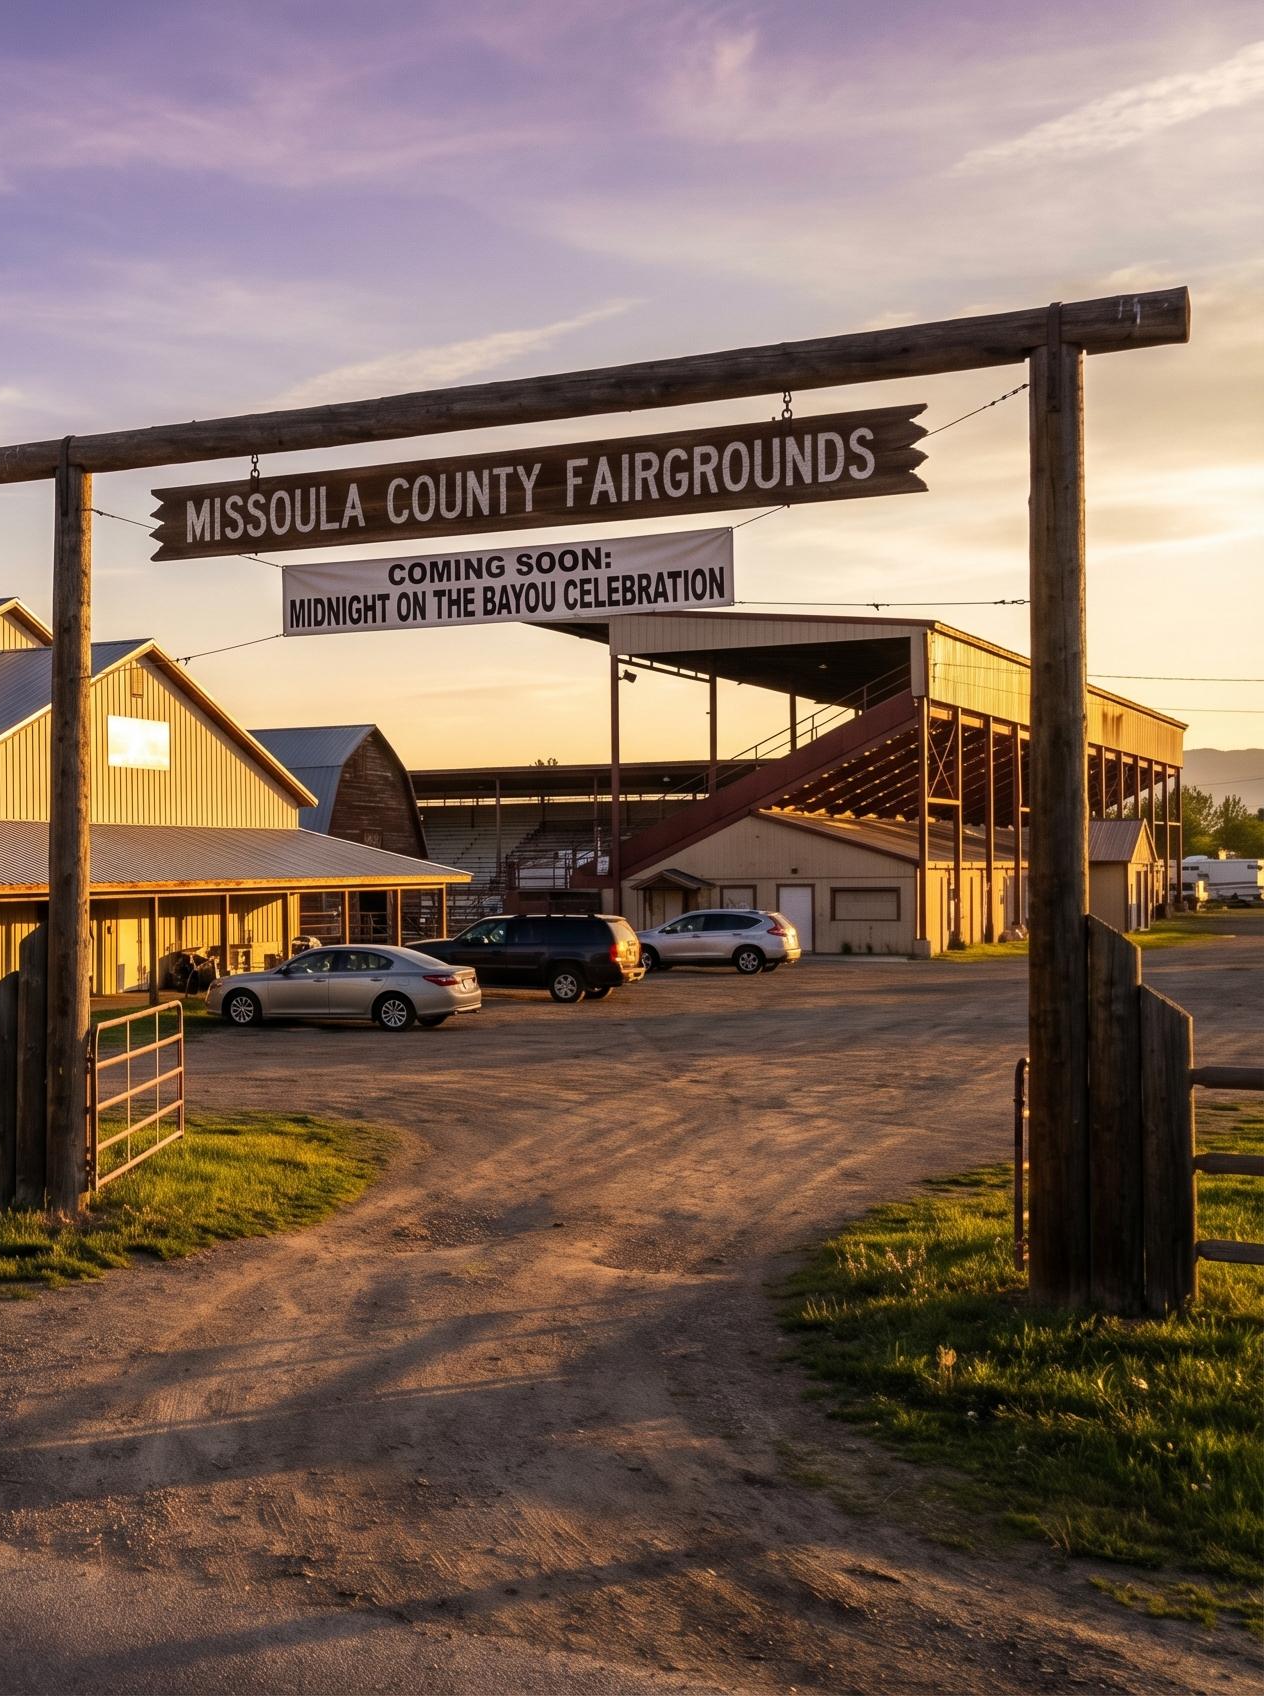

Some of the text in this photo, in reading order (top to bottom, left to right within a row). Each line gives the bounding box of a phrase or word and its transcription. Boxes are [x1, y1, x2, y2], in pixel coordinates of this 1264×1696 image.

[186, 427, 877, 543] MISSOULA COUNTY FAIRGROUNDS
[289, 566, 725, 629] MIDNIGHT ON THE BAYOU CELEBRATION
[387, 546, 613, 587] COMING SOON:
